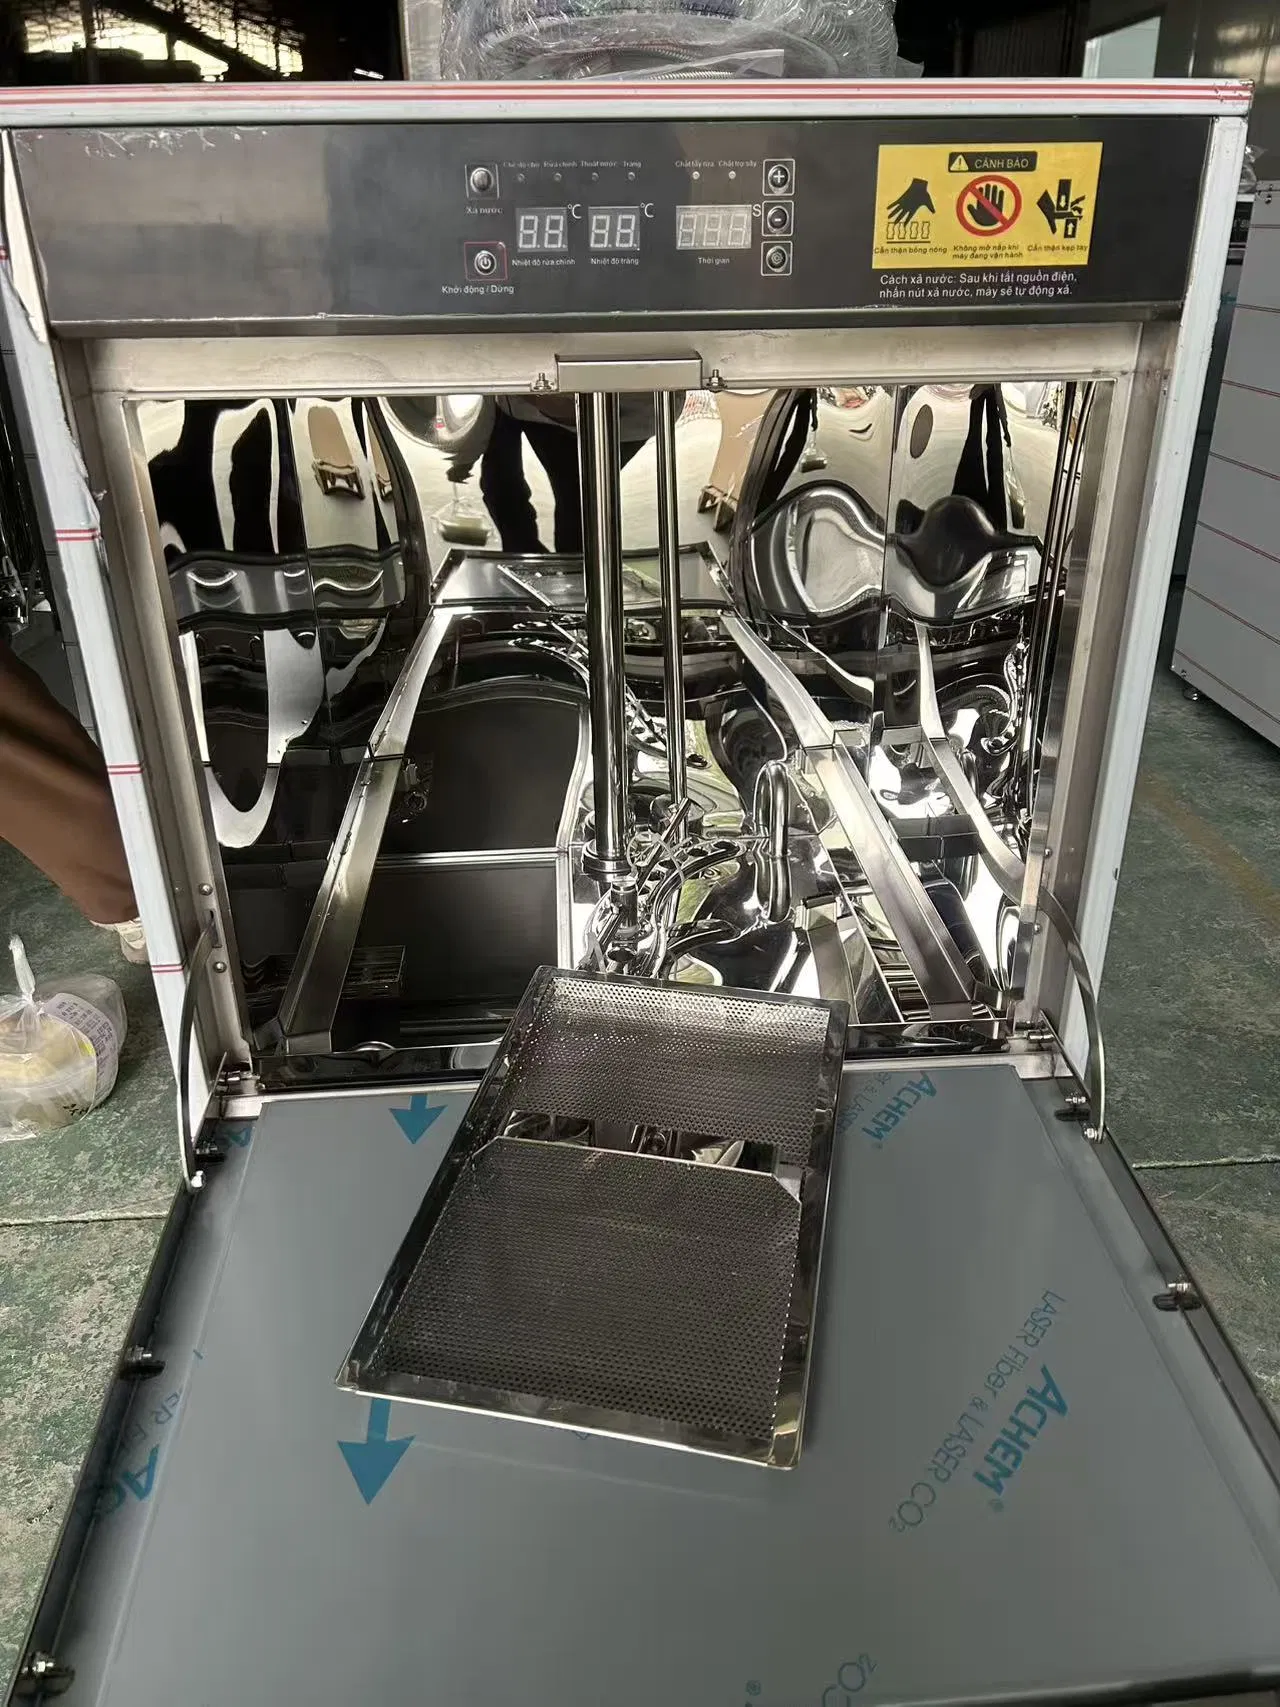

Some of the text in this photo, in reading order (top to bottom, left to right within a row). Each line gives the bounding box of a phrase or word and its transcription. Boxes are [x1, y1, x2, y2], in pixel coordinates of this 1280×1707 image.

[880, 273, 908, 285] Cách
[959, 272, 980, 284] Sau
[982, 272, 998, 283] khi
[975, 286, 999, 298] máy
[1015, 1289, 1066, 1349] LASER
[927, 1411, 985, 1484] LASER
